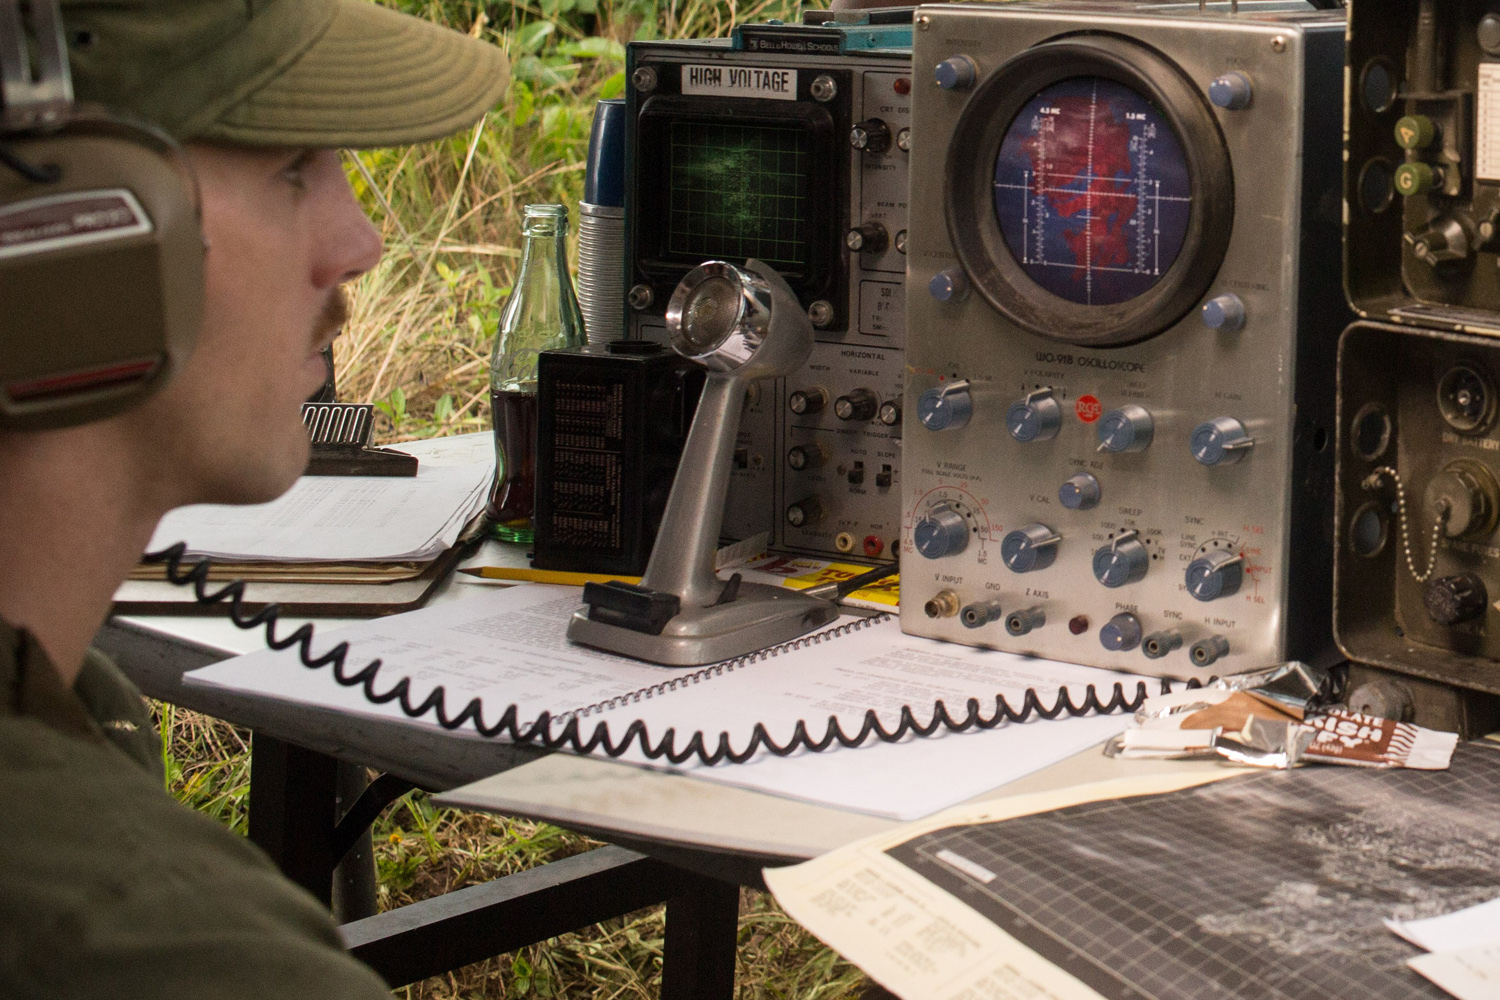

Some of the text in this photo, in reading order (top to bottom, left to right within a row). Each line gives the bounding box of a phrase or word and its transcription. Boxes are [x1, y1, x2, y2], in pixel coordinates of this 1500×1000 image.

[690, 67, 722, 88] HIGH
[1399, 127, 1415, 144] A
[1401, 172, 1414, 190] G
[841, 350, 885, 360] HORIZONTAL
[810, 364, 830, 372] WIDTH
[1078, 356, 1146, 373] OSCILLOSCOPE
[849, 368, 879, 376] VARIABLE
[863, 431, 888, 439] TRIGGER
[1462, 436, 1500, 451] BATTERY
[877, 451, 896, 459] SLOPE
[943, 462, 966, 471] RANGE
[1119, 506, 1143, 517] SWEEP
[1184, 515, 1204, 525] SYNC
[1180, 533, 1196, 541] LINE
[934, 573, 963, 585] V INPUT
[985, 582, 1001, 591] GND
[1025, 588, 1049, 599] Z AXIS
[1115, 602, 1139, 611] PHASE
[1163, 610, 1183, 620] SYNC
[1213, 618, 1236, 628] INPUT
